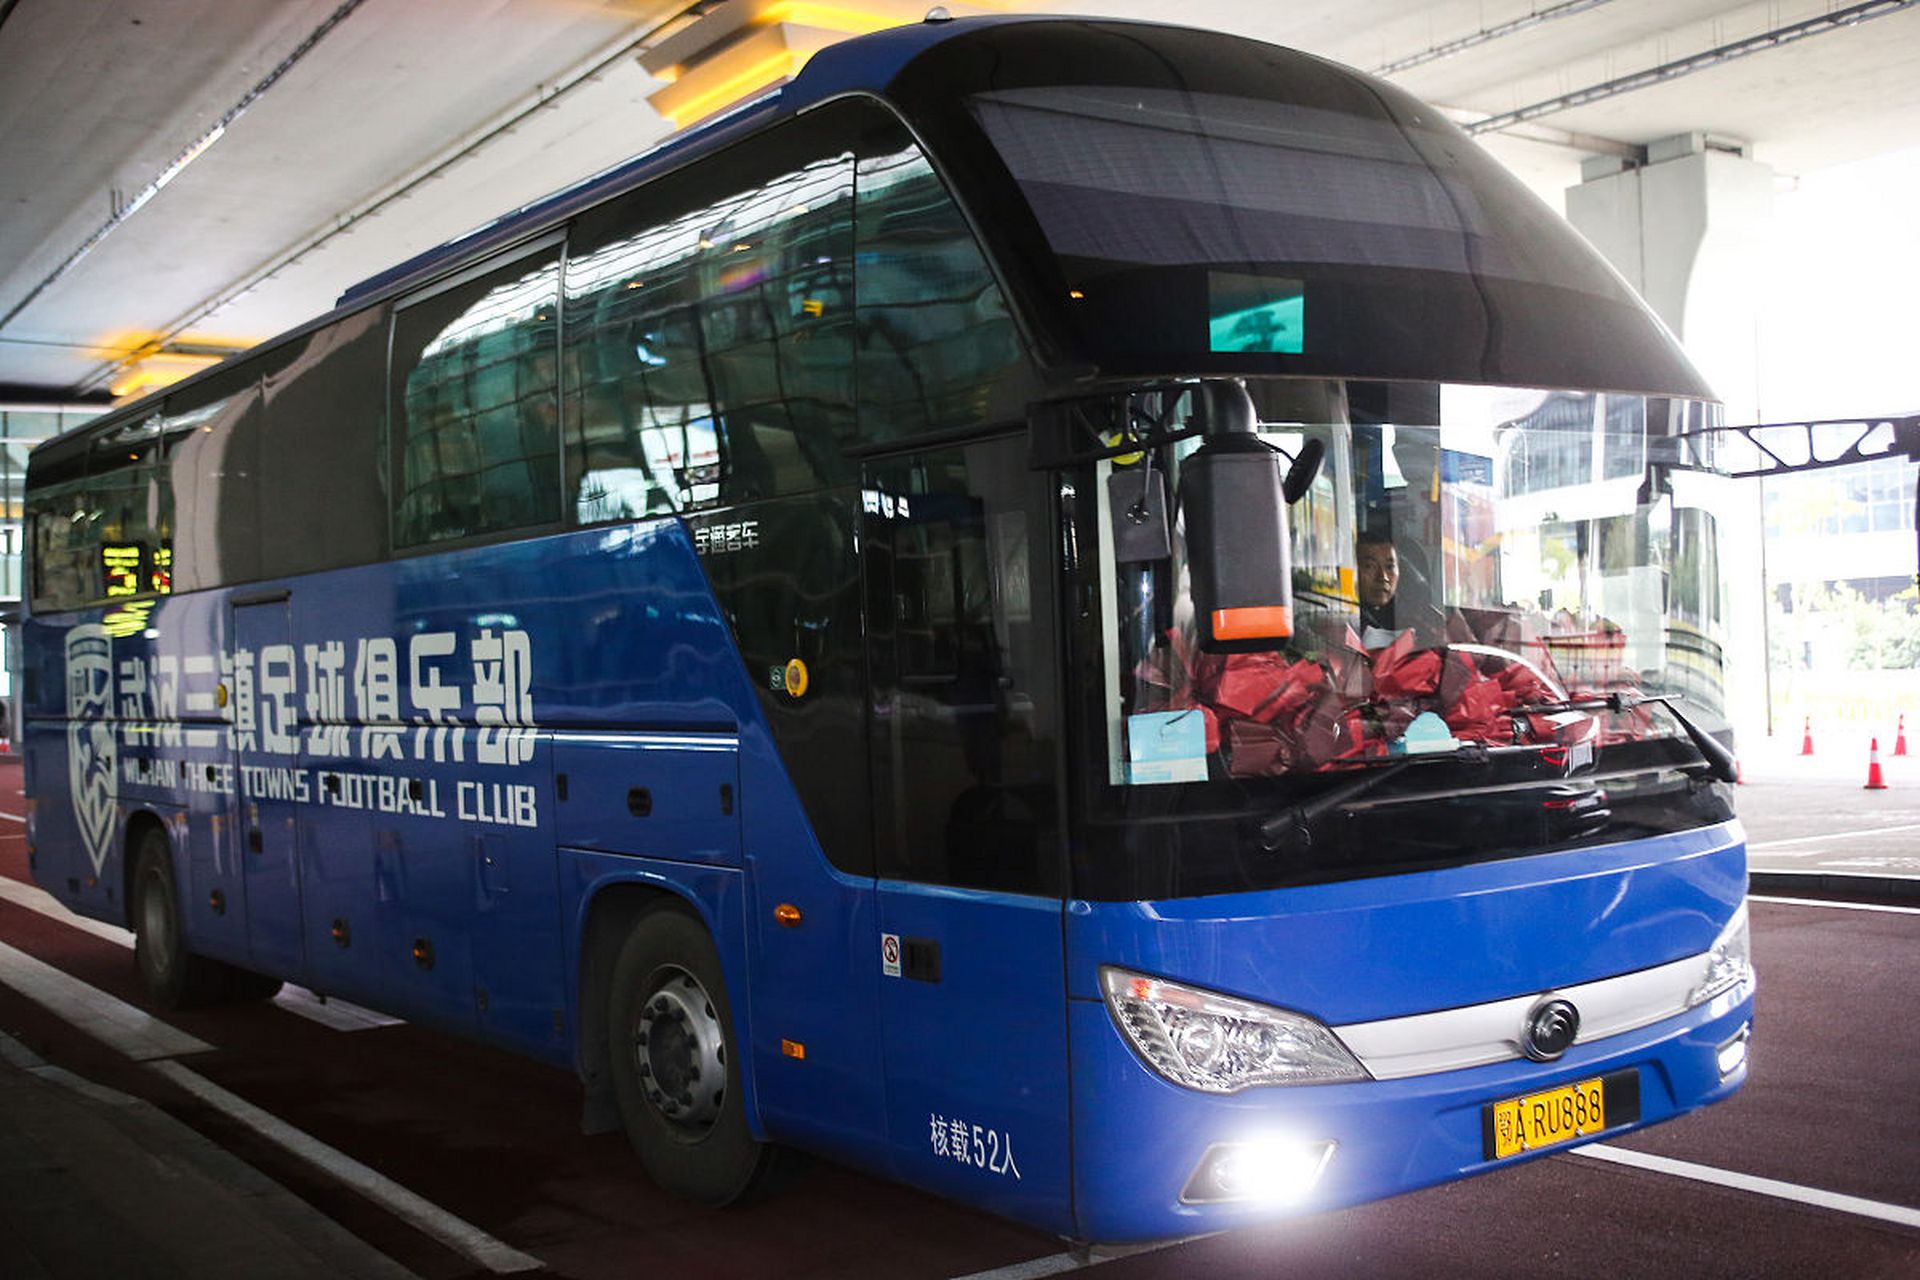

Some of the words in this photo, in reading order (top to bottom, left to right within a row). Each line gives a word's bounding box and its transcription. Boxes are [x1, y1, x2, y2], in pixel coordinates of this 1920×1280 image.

[120, 629, 538, 765] 武汉三镇足球俱乐部
[124, 756, 176, 788] WUHAN
[182, 762, 235, 794] THREE
[240, 766, 310, 803] TOWNS
[318, 771, 446, 818] FOOTBALL
[457, 781, 538, 827] CLUB
[930, 1113, 1021, 1180] 核载52人
